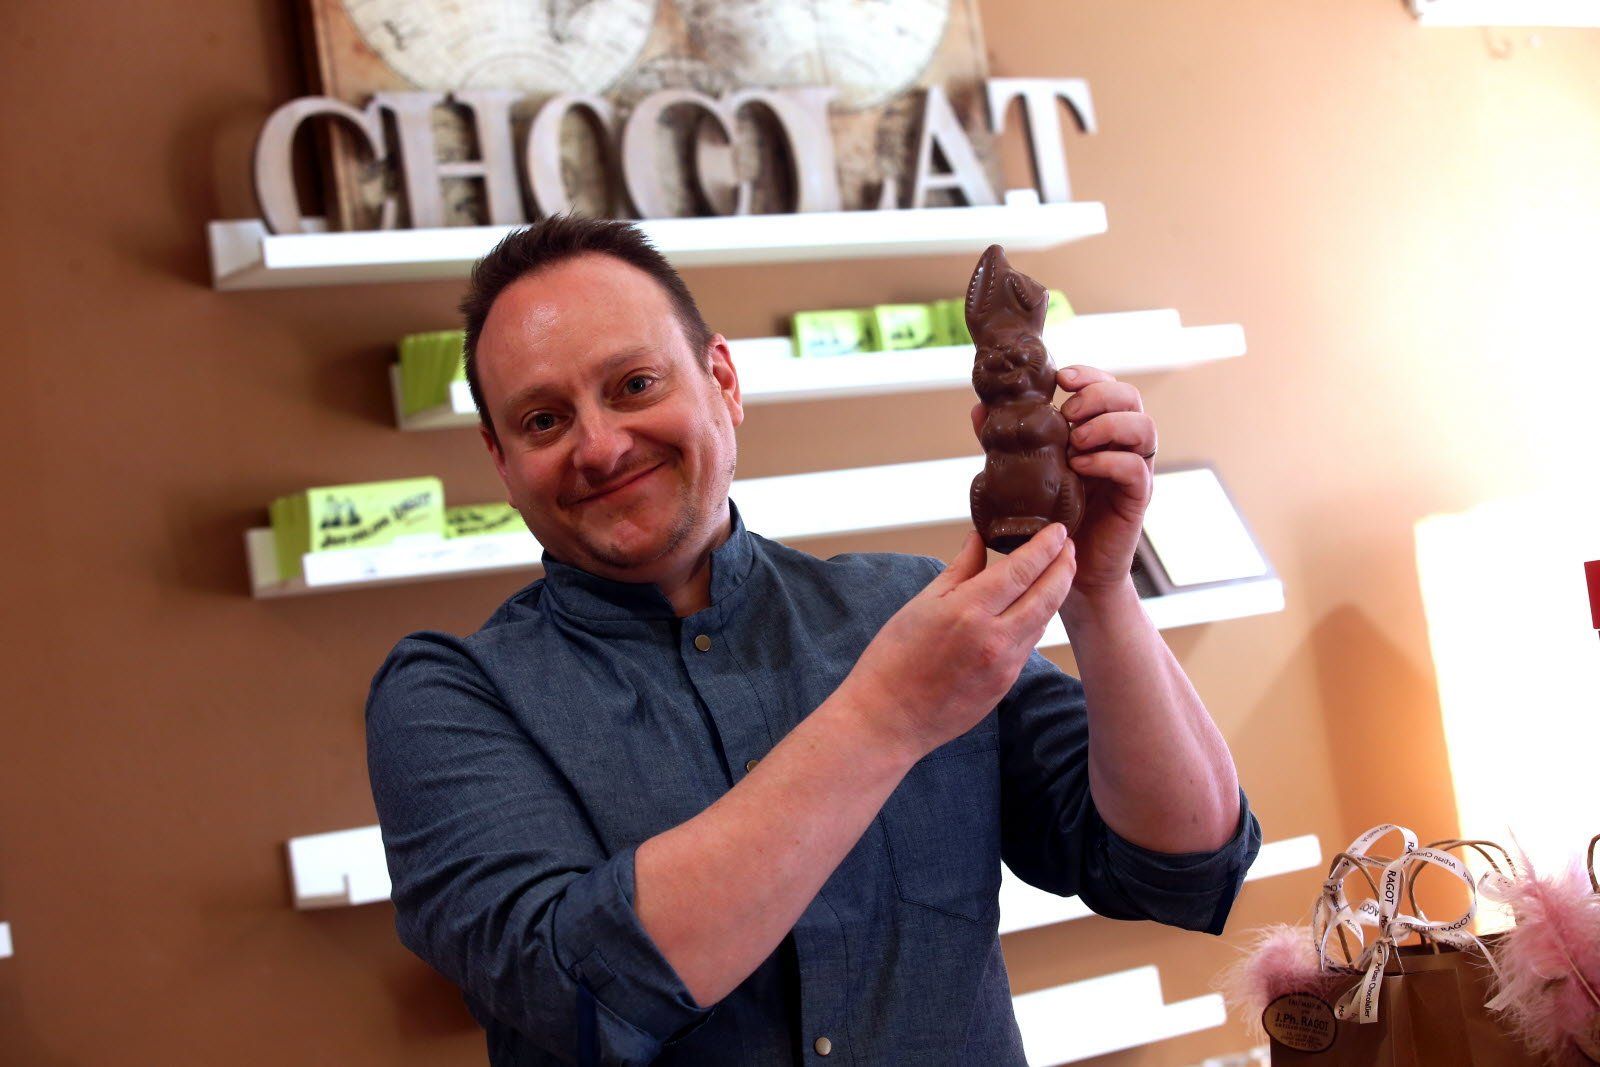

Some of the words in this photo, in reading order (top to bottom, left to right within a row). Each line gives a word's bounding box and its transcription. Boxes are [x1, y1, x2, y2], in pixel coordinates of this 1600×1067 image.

[254, 77, 1097, 234] CHOCOLAT
[1384, 869, 1397, 905] RAGOT
[1371, 962, 1383, 982] Artisan
[1301, 1015, 1330, 1032] RAGOT
